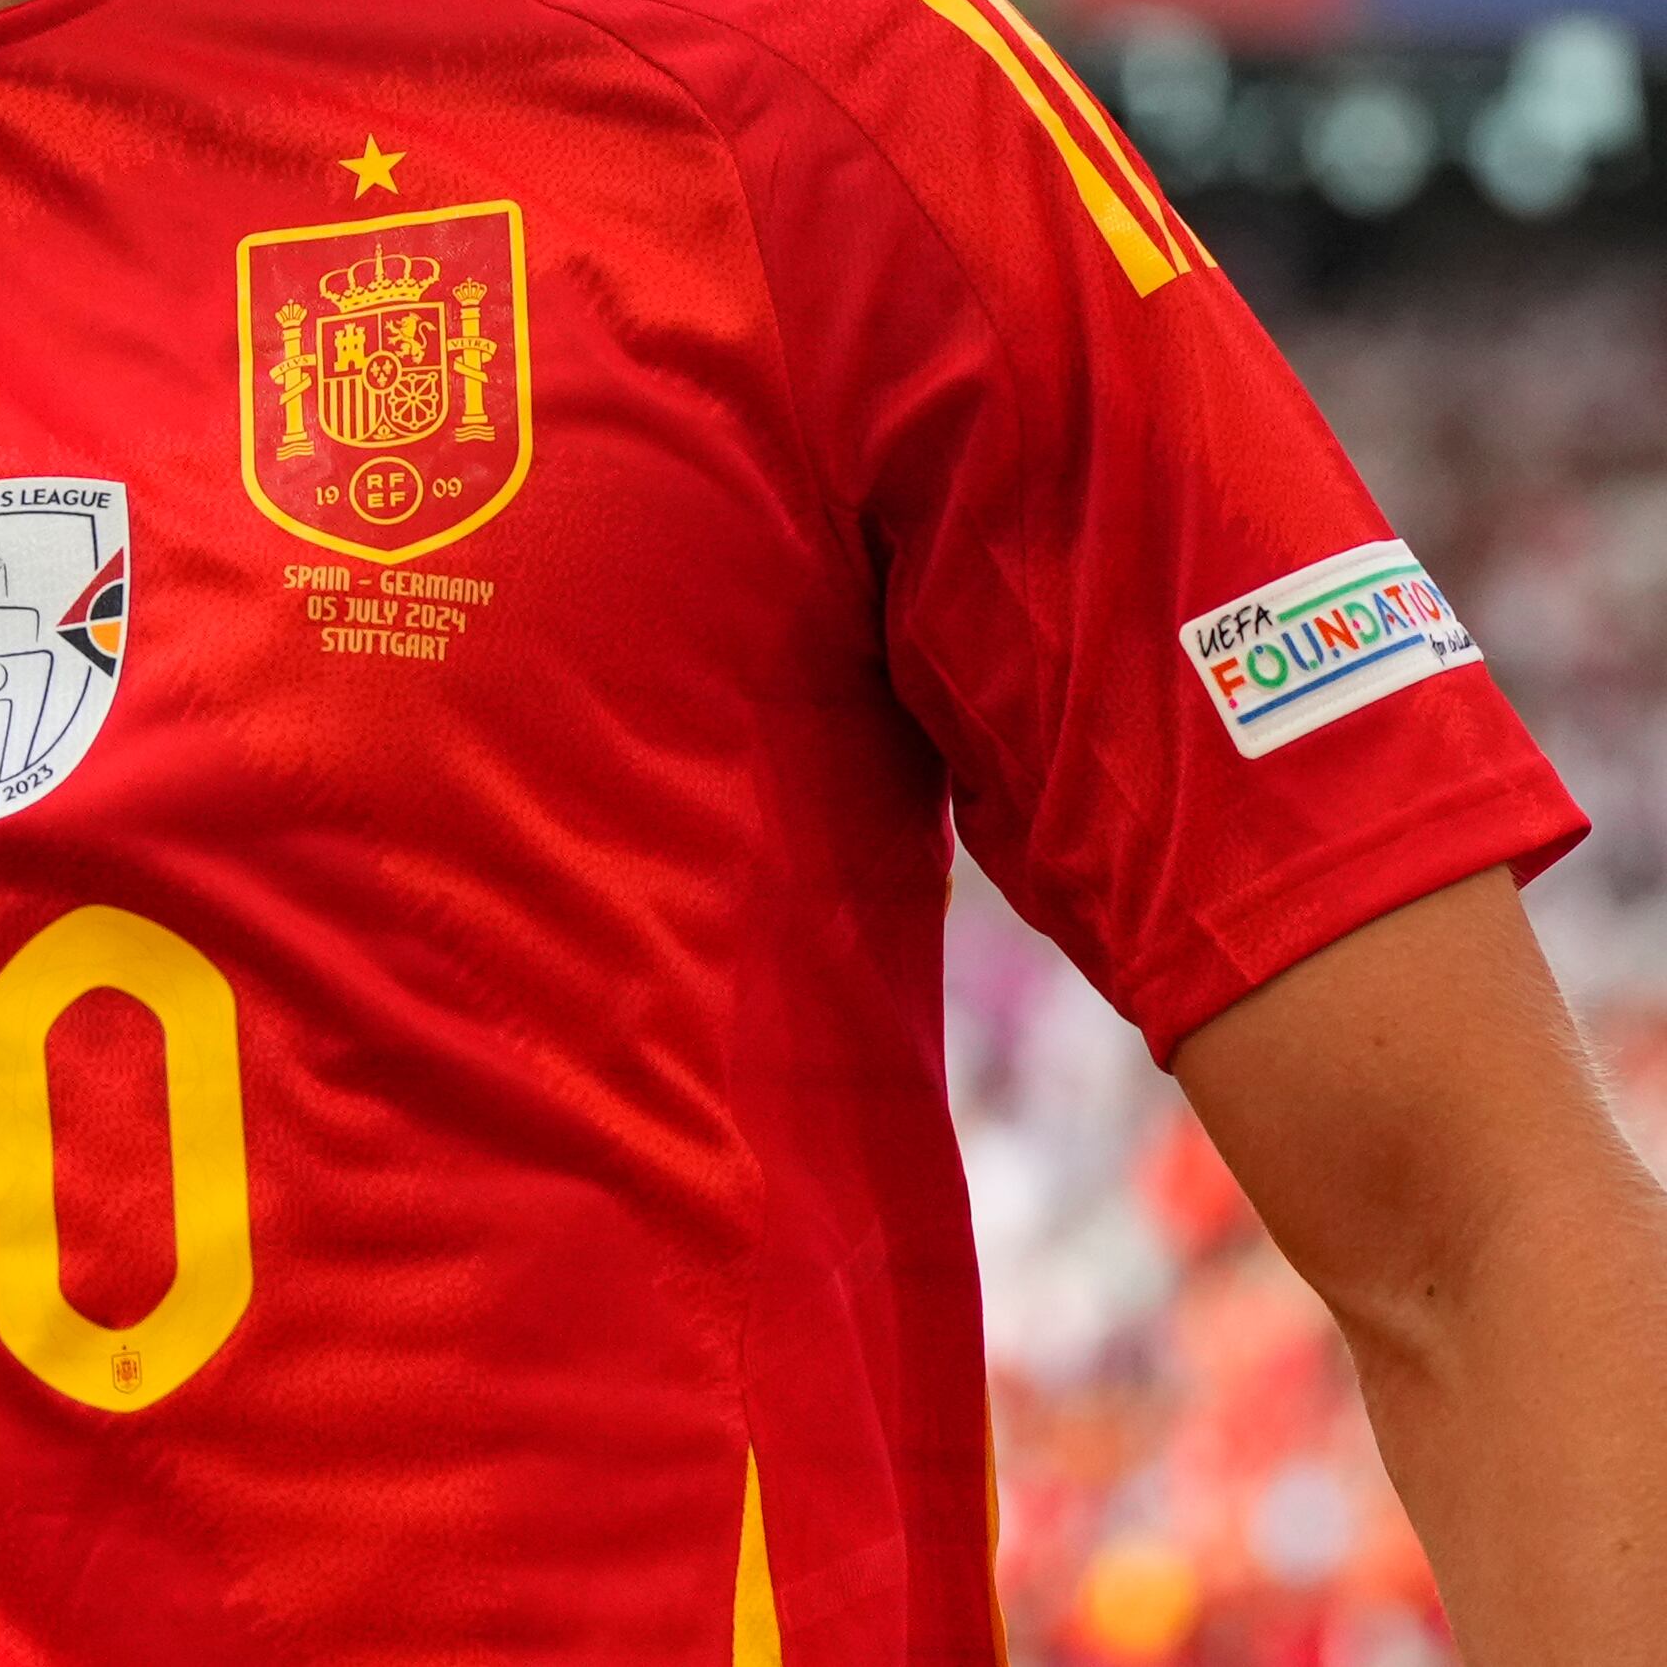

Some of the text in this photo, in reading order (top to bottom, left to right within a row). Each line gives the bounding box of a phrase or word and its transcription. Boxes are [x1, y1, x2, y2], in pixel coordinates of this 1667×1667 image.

[20, 488, 111, 510] LEAGUE
[316, 485, 340, 506] 19
[431, 476, 463, 499] 09
[283, 565, 351, 592] SPAIN
[379, 569, 494, 606] GERMANY
[307, 594, 467, 634] 05 JULY 2024
[1197, 604, 1275, 660] UEFA
[320, 626, 450, 662] STUTTGART
[3, 763, 55, 802] 2023
